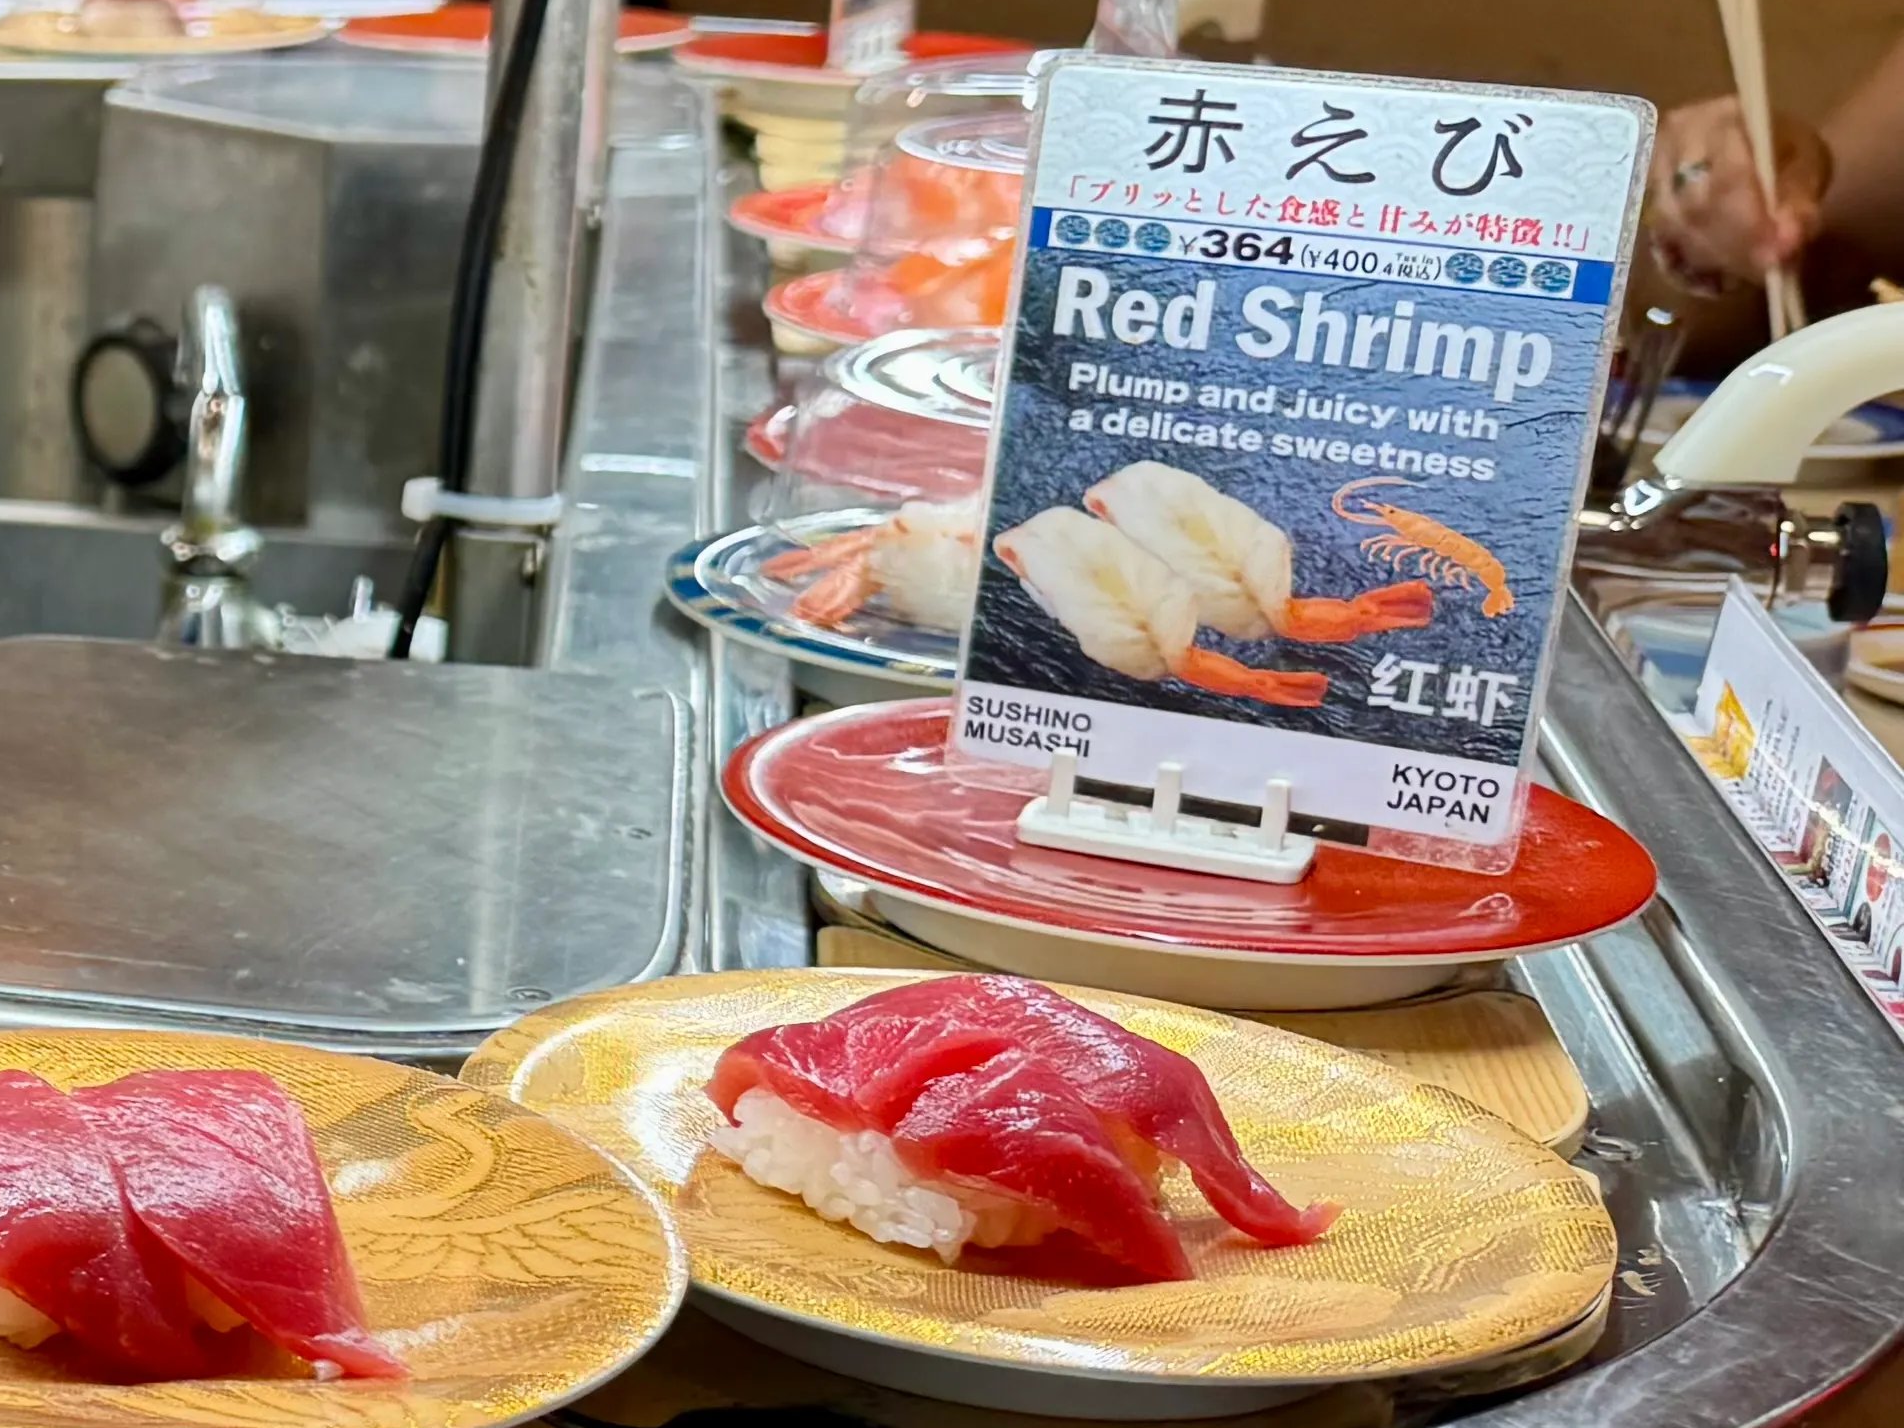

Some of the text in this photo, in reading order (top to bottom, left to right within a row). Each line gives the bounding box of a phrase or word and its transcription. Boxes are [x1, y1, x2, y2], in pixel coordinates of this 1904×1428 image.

[1143, 88, 1533, 198] 赤えび
[1179, 229, 1294, 265] ¥364
[1053, 265, 1553, 403] Red Shrimp
[1069, 364, 1499, 440] Plump and juicy with
[1069, 407, 1496, 481] a delicate sweetness
[966, 695, 1092, 732] SUSHINO
[1366, 654, 1519, 727] 红虾
[963, 720, 1091, 758] MUSASHI
[1386, 790, 1491, 824] JAPAN
[1392, 763, 1500, 800] KYOTO
